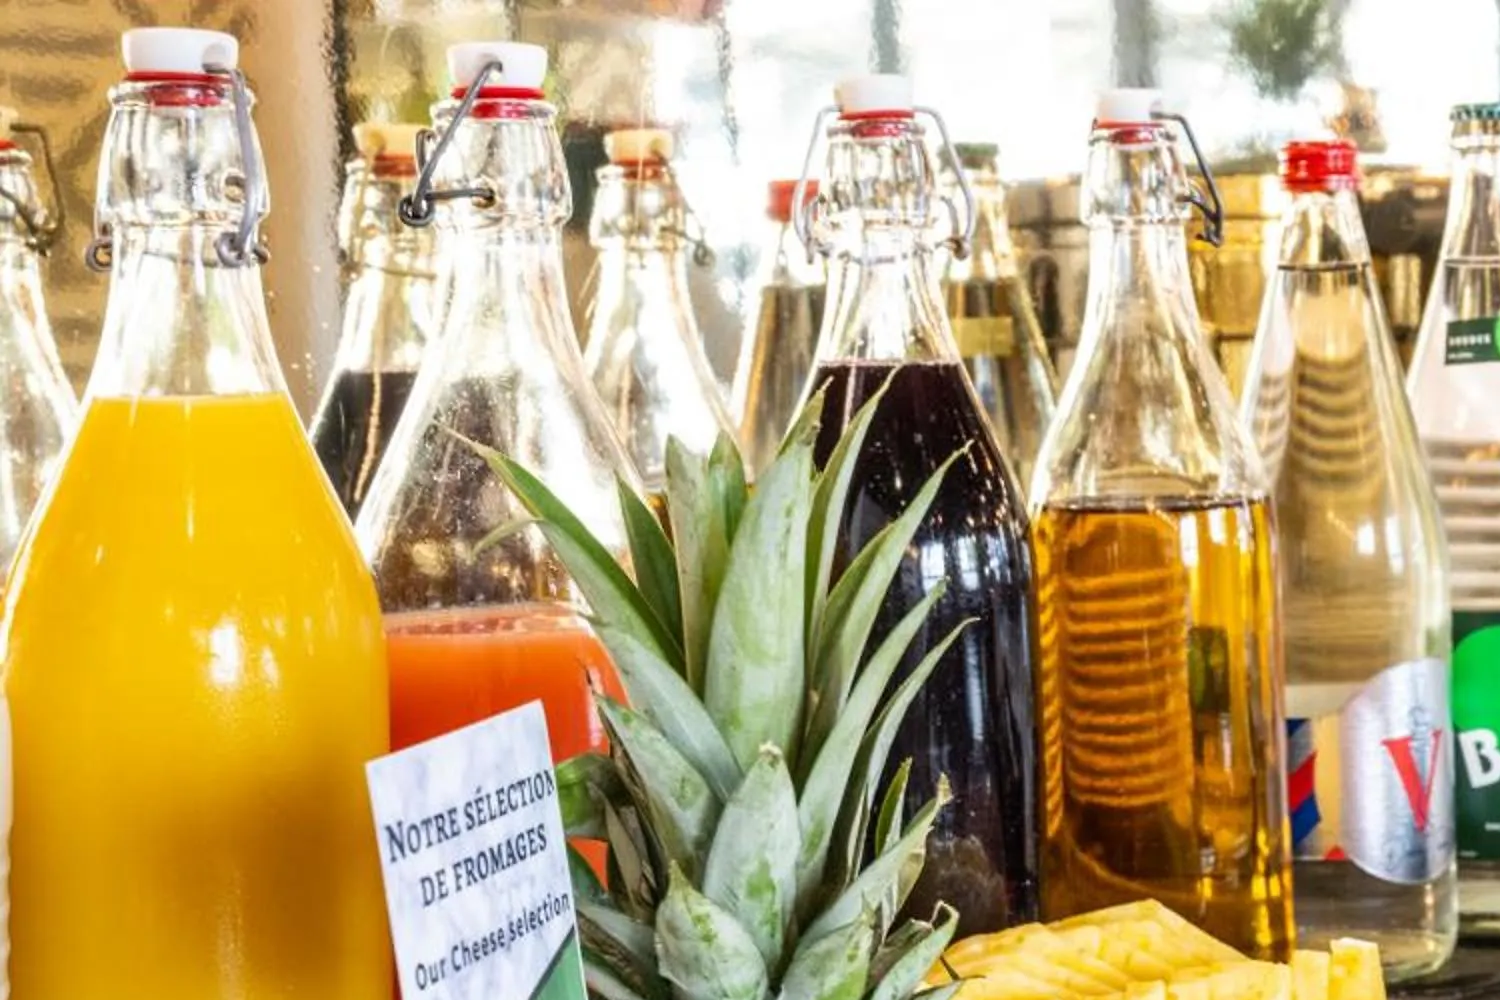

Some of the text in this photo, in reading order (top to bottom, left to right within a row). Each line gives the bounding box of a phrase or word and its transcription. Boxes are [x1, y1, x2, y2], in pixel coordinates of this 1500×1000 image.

[420, 823, 548, 907] DE FROMAGES
[415, 890, 571, 991] Our Cheese selection
